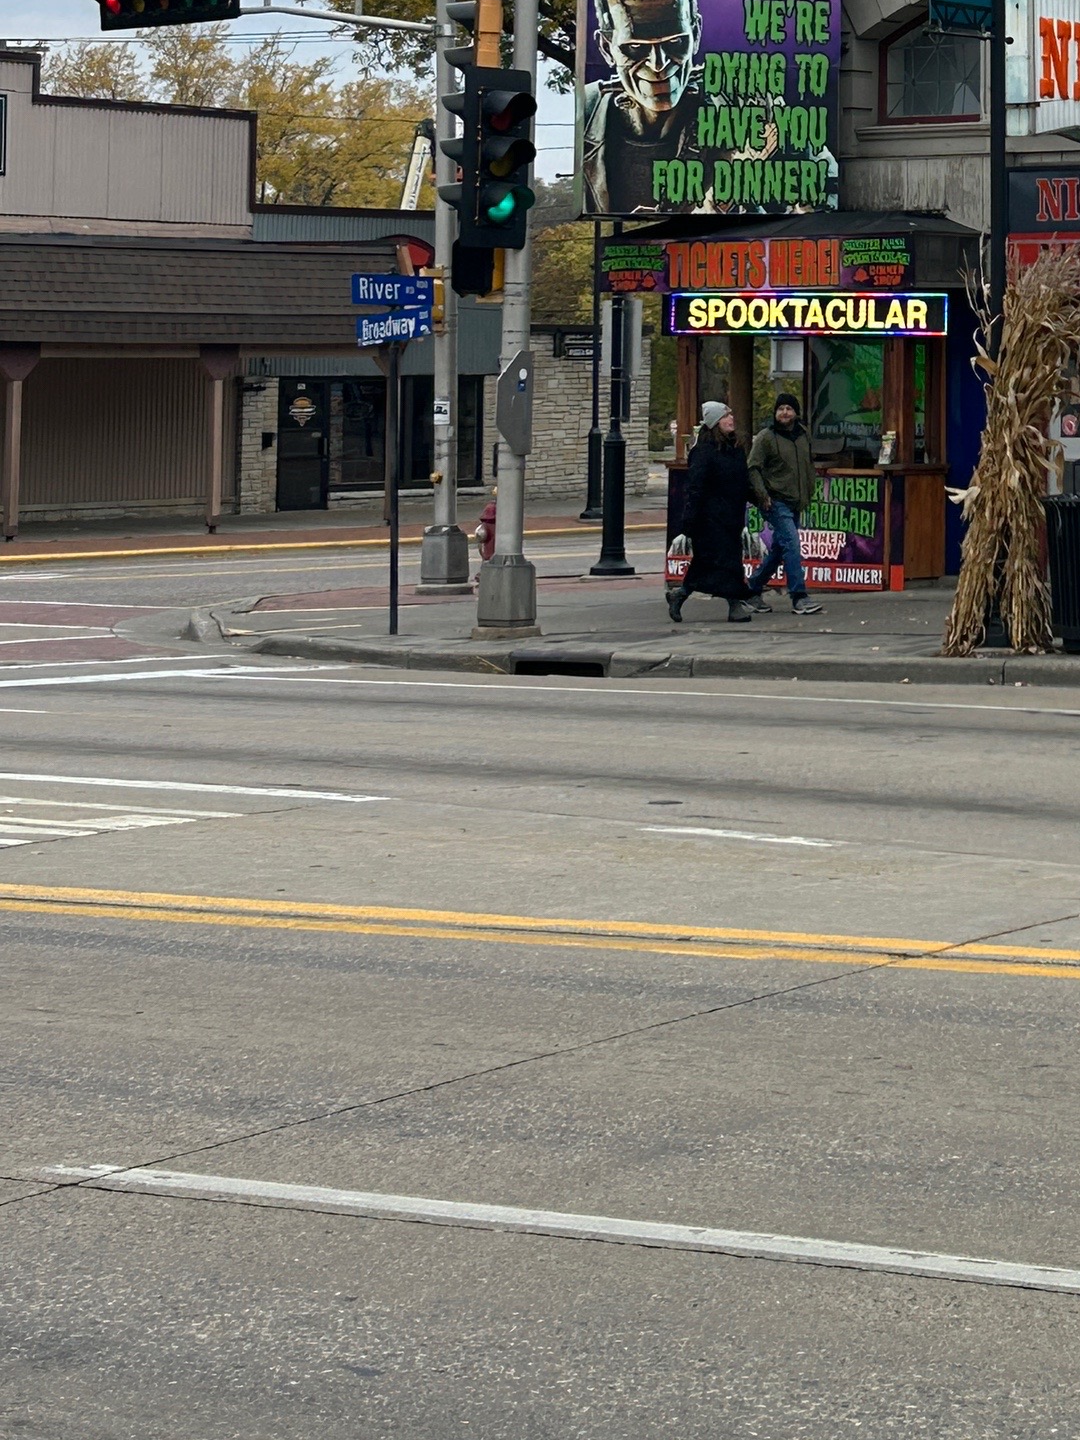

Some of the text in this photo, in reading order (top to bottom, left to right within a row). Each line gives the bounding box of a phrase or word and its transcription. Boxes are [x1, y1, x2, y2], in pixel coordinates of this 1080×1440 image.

[704, 52, 831, 98] DYING TO
[697, 105, 828, 155] HAVE YOU
[652, 160, 828, 209] FOR DINNER!
[666, 240, 766, 289] TICKETS
[769, 239, 840, 287] HERE!
[359, 277, 401, 300] River
[362, 315, 415, 340] Broadway
[688, 298, 928, 330] SPOOKTACULAR
[829, 476, 878, 502] MASH
[801, 544, 839, 557] SHOW
[812, 567, 832, 582] FOR
[835, 567, 883, 585] DINNER!
